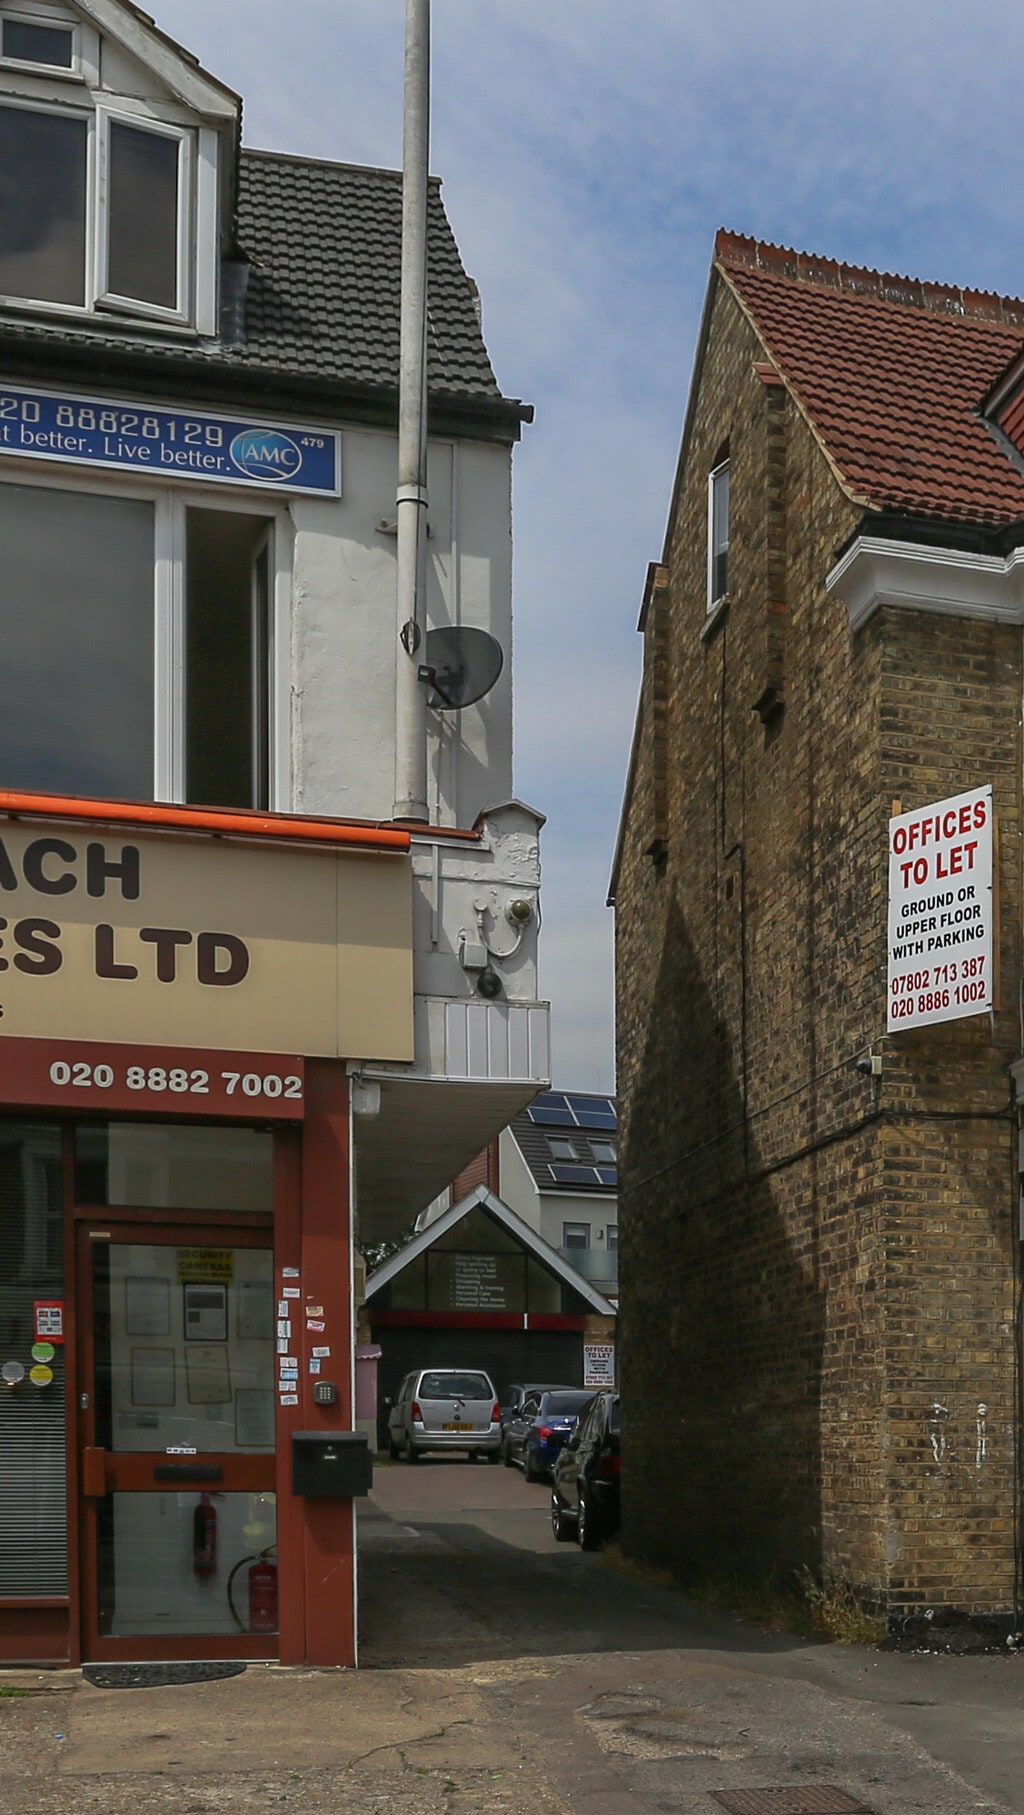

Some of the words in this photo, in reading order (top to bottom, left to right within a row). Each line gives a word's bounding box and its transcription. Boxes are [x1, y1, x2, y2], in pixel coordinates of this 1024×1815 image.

[56, 405, 223, 447] 88828129
[301, 437, 324, 448] 479
[20, 423, 93, 453] better.
[105, 436, 150, 460] Live
[160, 443, 231, 471] better.
[244, 445, 296, 466] AMC
[893, 800, 987, 855] OFFICES
[0, 837, 140, 900] CH
[900, 857, 928, 889] TO
[936, 841, 978, 879] LET
[901, 890, 954, 918] GROUND
[957, 885, 975, 902] OR
[896, 917, 936, 939] UPPER
[940, 904, 981, 928] FLOOR
[0, 917, 63, 976] S
[94, 923, 250, 986] LTD
[893, 939, 923, 960] WITH
[927, 924, 984, 952] PARKING
[892, 969, 929, 995] 07802
[933, 963, 957, 986] 713
[961, 956, 985, 978] 387
[891, 997, 914, 1019] 020
[918, 989, 950, 1012] 8886
[954, 980, 985, 1004] 1002
[49, 1061, 114, 1088] 020
[126, 1066, 210, 1094] 8882
[221, 1072, 303, 1099] 7002
